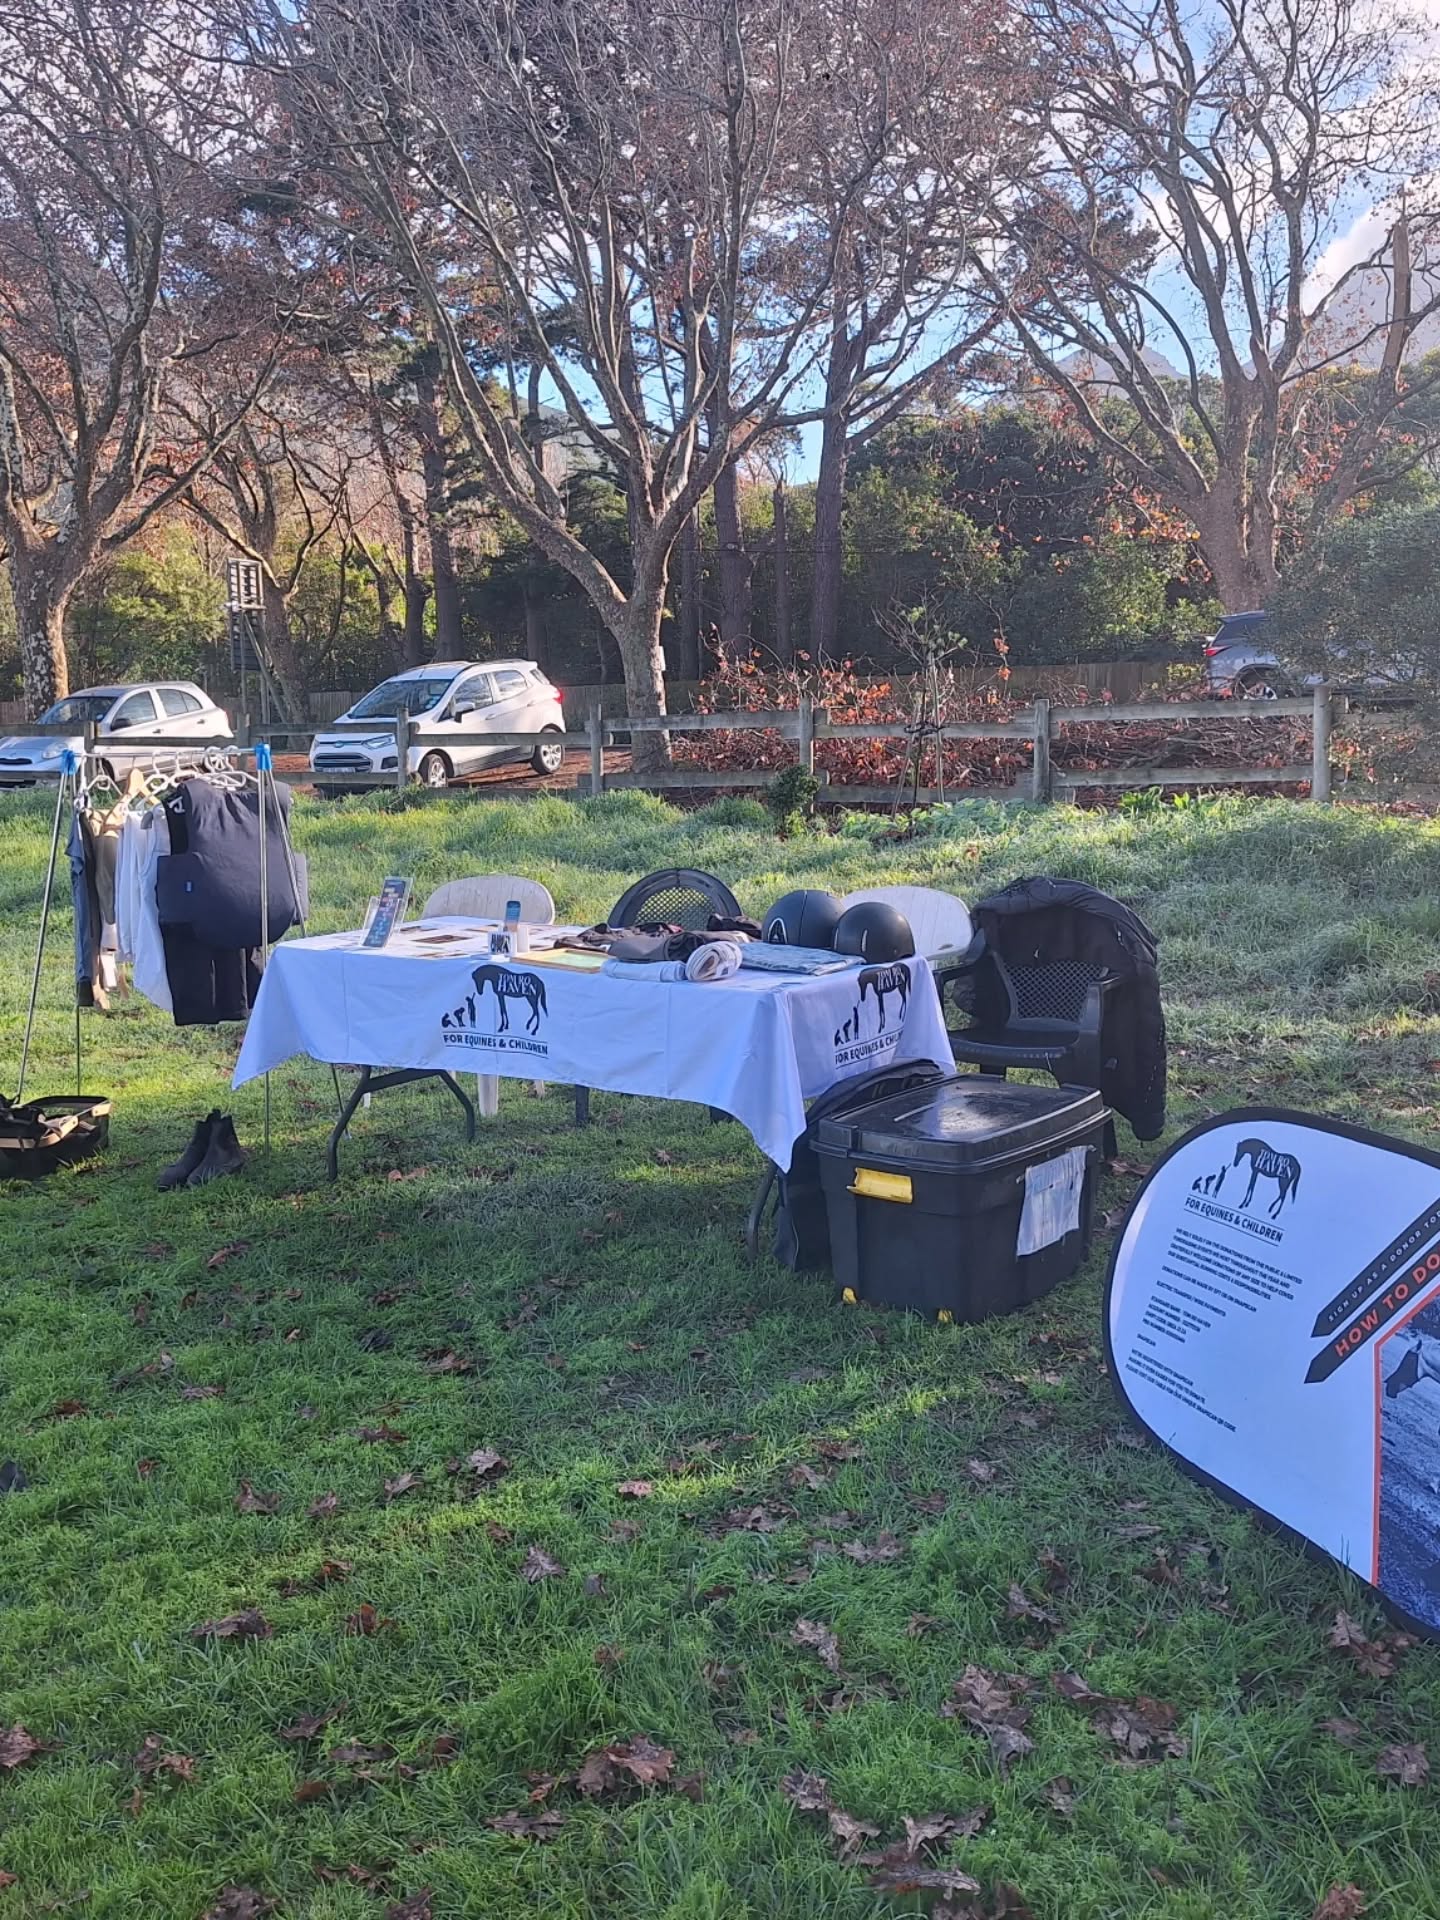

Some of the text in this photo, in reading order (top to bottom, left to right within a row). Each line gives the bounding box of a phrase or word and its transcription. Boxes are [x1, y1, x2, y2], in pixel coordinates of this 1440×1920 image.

[498, 980, 538, 996] HAVEN
[443, 1034, 548, 1055] FOR EQUINES & CHILDREN
[835, 1050, 849, 1065] FOR
[850, 1041, 879, 1060] EQUINES
[879, 1038, 885, 1049] &
[1185, 1197, 1284, 1242] FOR EQUINES & CHILDREN
[1328, 1299, 1350, 1323] SIGN
[1351, 1285, 1364, 1299] UP
[1366, 1271, 1379, 1286] AS
[1381, 1263, 1388, 1272] A
[1389, 1230, 1422, 1262] DONOR
[1334, 1246, 1440, 1358] HOW TO DO
